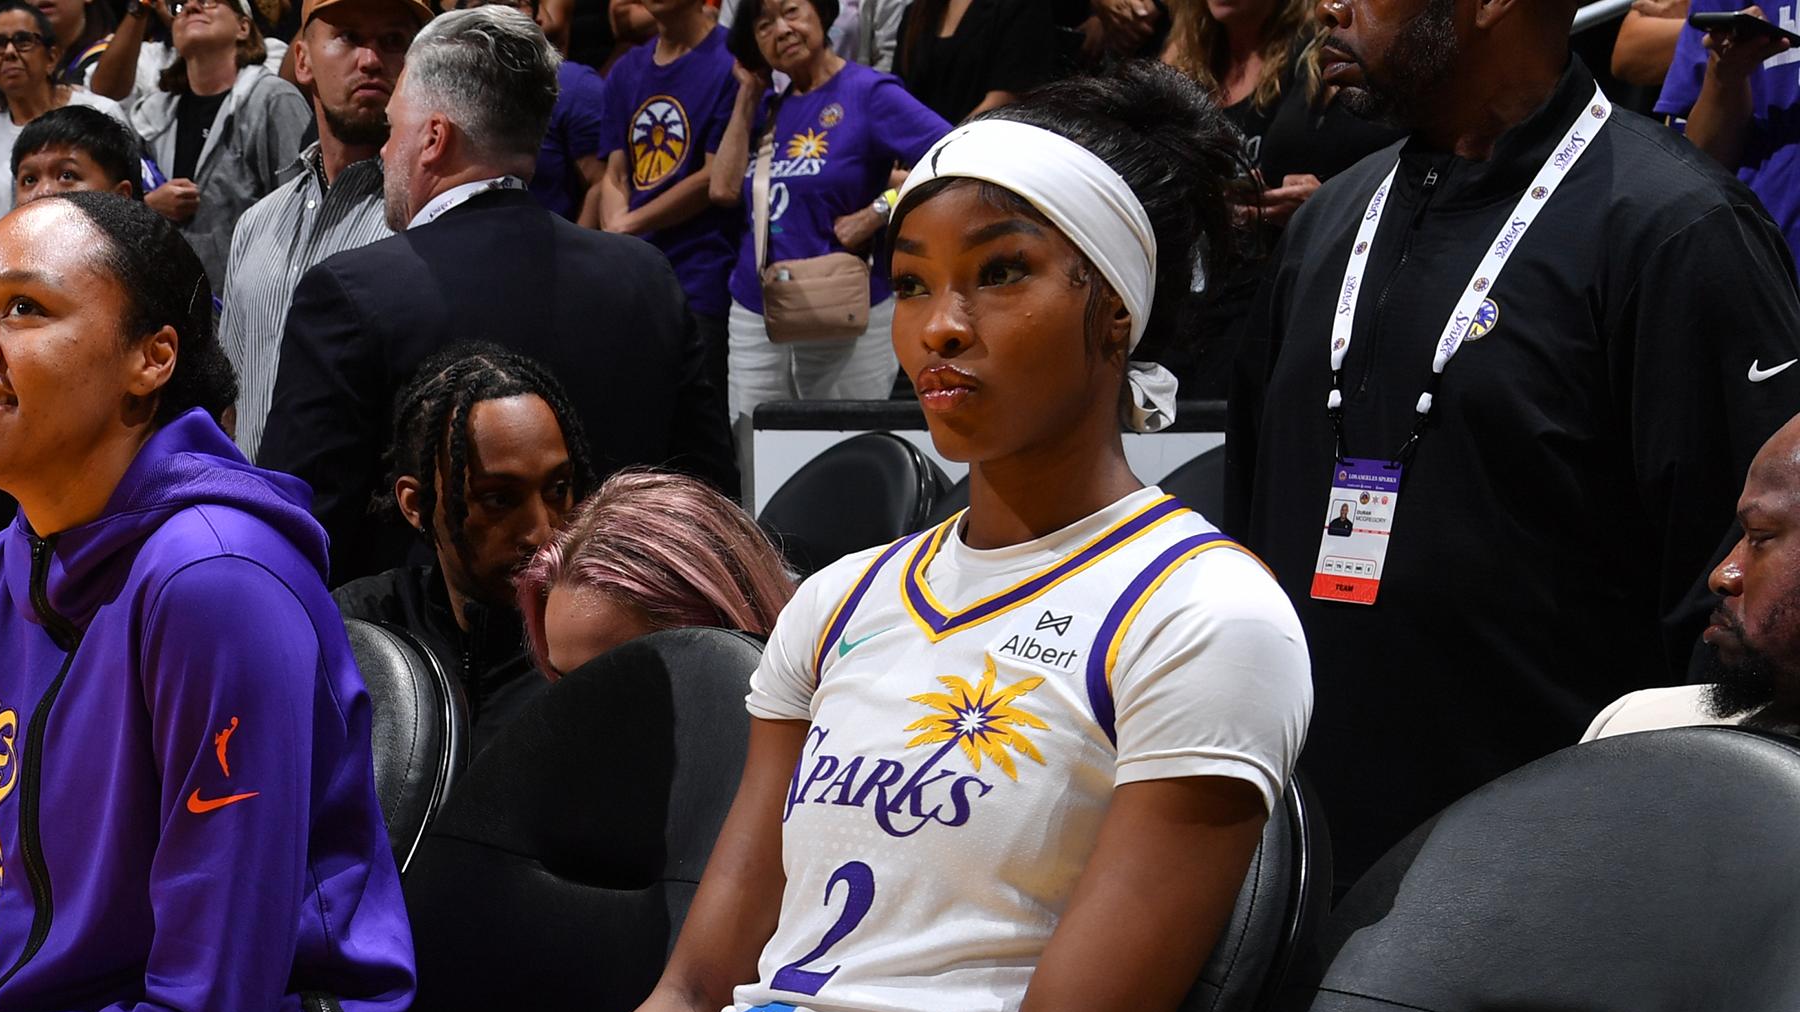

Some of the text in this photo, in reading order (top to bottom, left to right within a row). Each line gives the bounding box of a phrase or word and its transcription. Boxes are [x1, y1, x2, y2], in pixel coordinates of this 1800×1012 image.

[1336, 583, 1354, 592] TEAM
[999, 634, 1078, 668] Albert
[783, 725, 994, 837] SPARKS
[770, 860, 875, 997] 2
